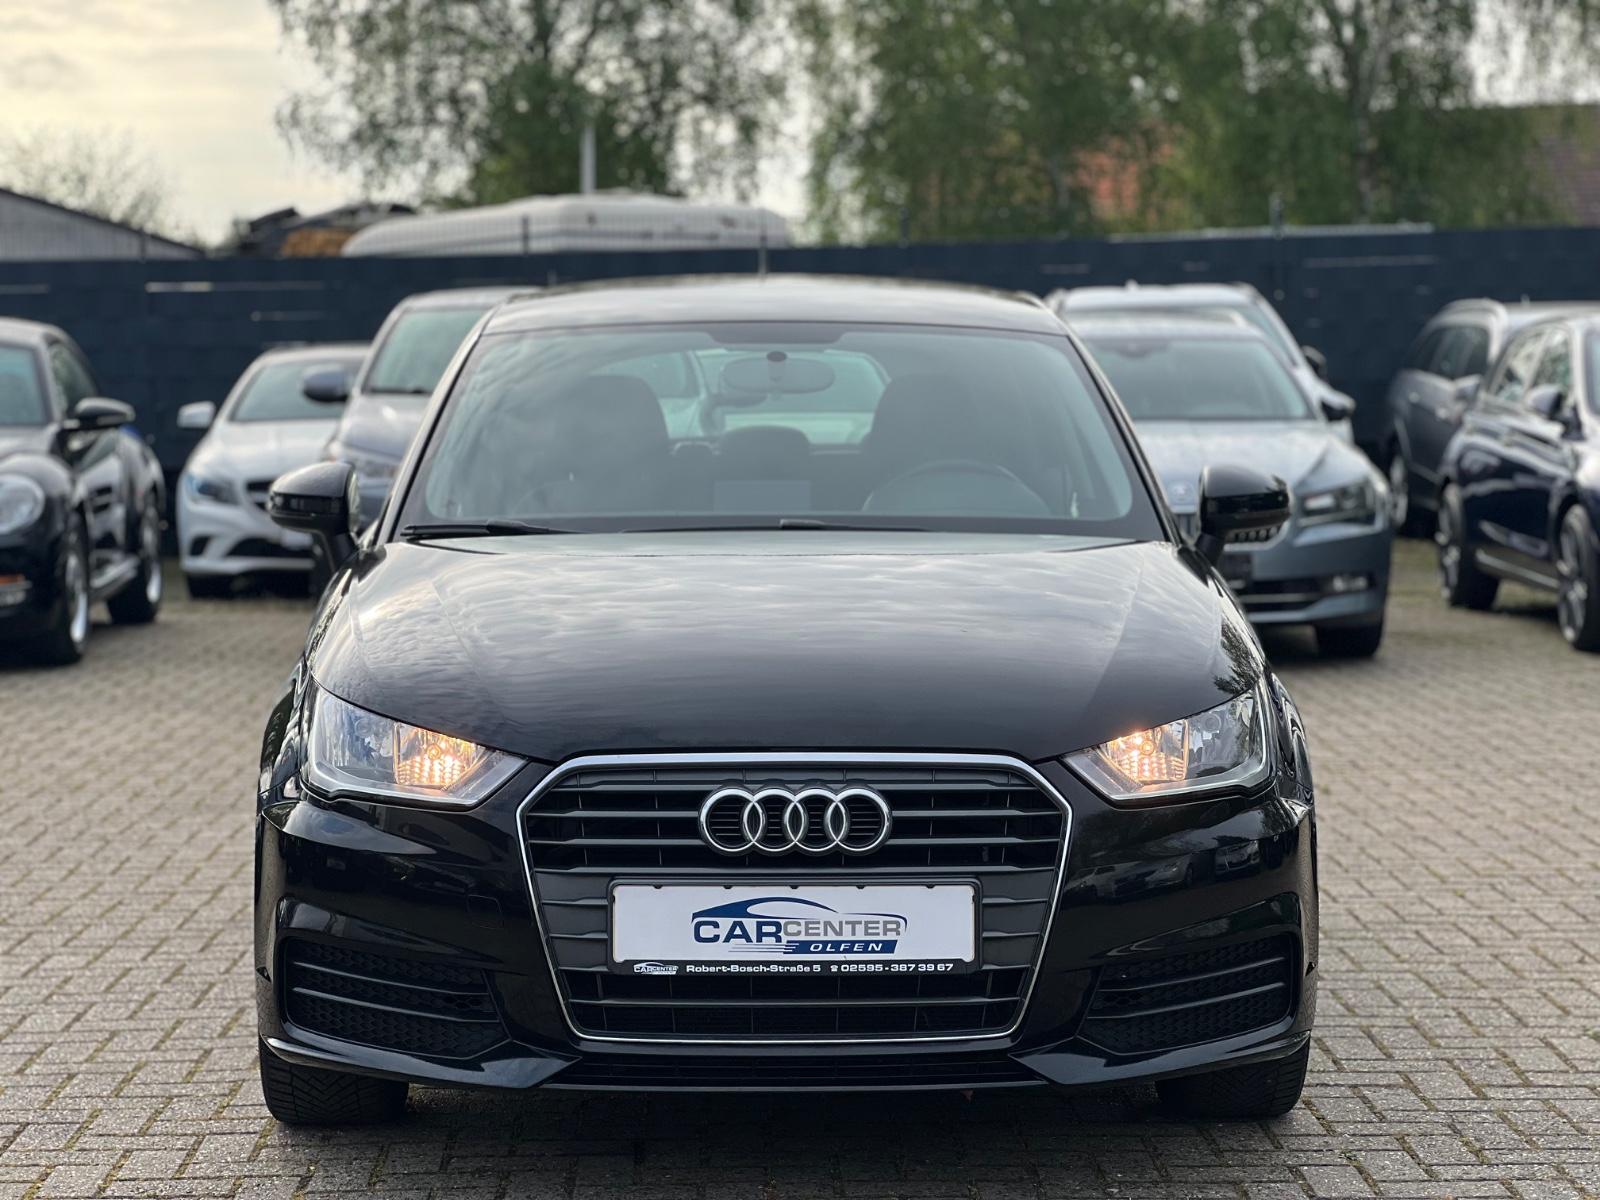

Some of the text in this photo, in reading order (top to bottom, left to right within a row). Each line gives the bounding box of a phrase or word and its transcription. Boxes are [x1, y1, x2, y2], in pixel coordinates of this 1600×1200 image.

[809, 943, 883, 951] OLFEN
[686, 965, 811, 973] Robert-Bosch-Straße
[937, 963, 954, 971] 67
